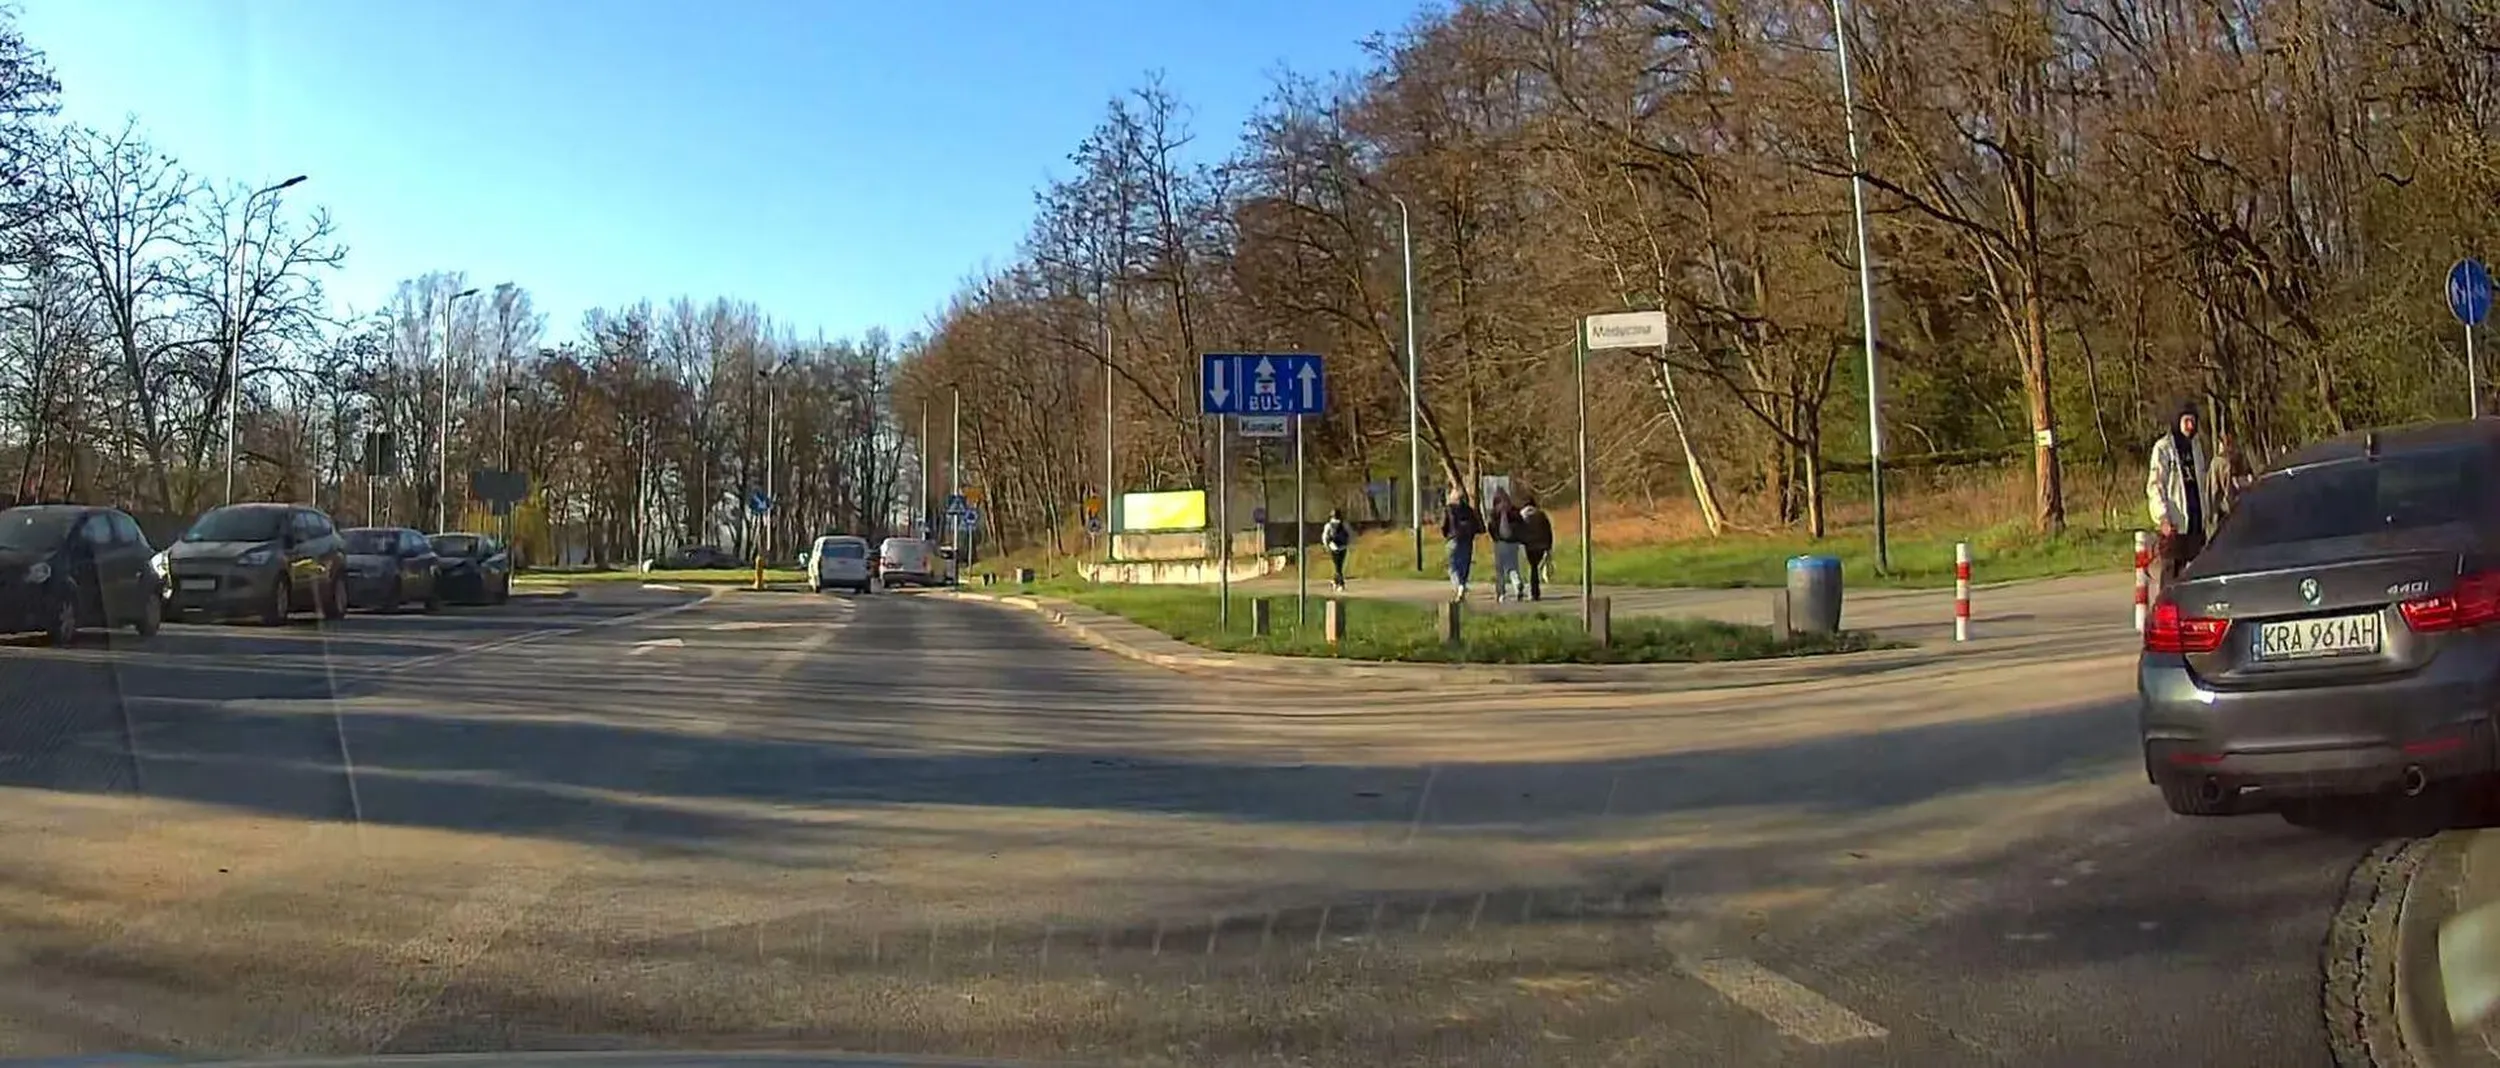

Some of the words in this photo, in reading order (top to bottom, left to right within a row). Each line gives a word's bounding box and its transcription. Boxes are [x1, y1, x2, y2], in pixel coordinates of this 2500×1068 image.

[1249, 395, 1282, 411] BUS
[2263, 623, 2302, 652] KRA
[2310, 616, 2375, 648] 961AH
